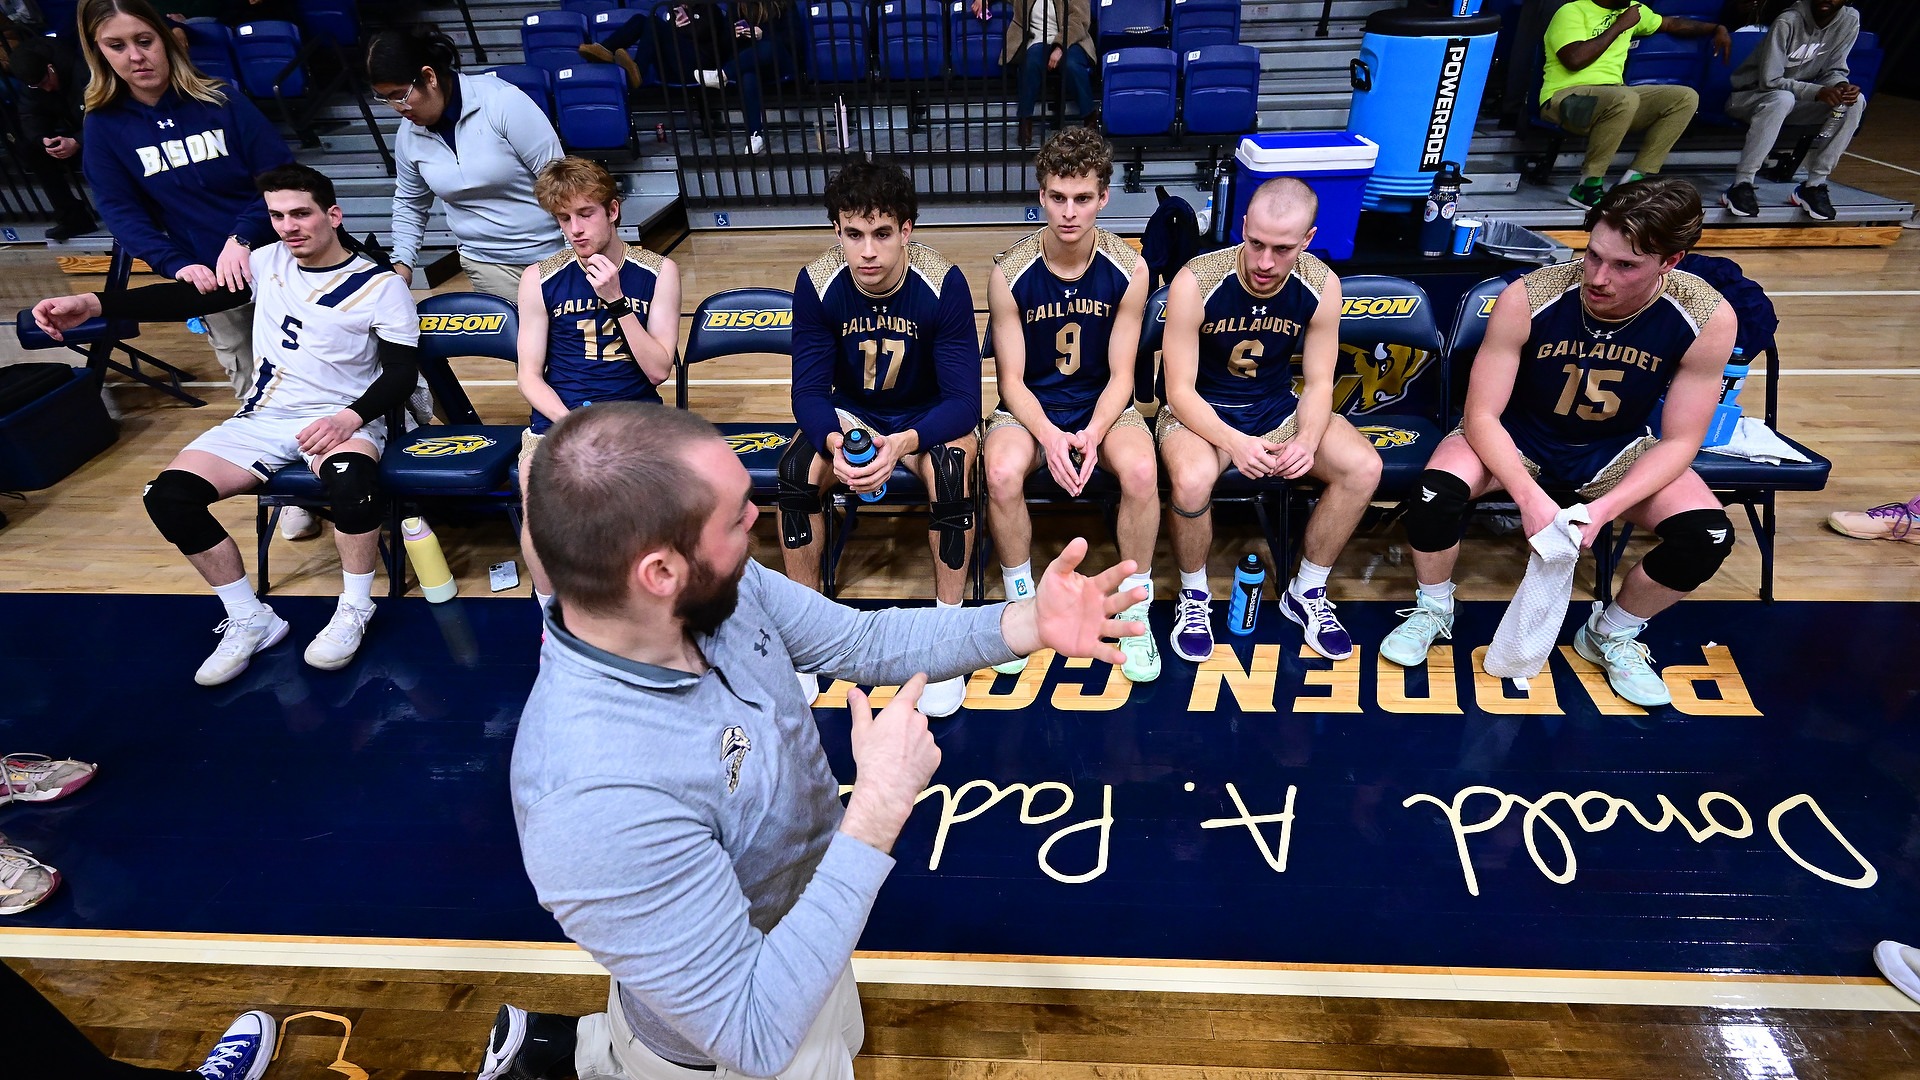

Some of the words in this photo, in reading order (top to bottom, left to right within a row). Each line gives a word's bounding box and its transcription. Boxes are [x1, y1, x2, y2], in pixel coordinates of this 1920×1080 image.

[1424, 46, 1466, 165] POWERADE
[136, 129, 229, 177] BISON
[419, 315, 503, 331] BISON
[707, 311, 793, 327] BISON
[1027, 298, 1112, 324] GALLAUDET
[1201, 316, 1302, 337] GALLAUDET
[1341, 298, 1417, 315] ISON
[281, 315, 302, 350] 5
[577, 318, 632, 361] 12
[1055, 322, 1081, 375] 9
[858, 338, 905, 390] 17
[1227, 339, 1264, 378] 6
[1537, 340, 1662, 373] GALLAUDET
[1553, 363, 1624, 421] 15
[1246, 587, 1259, 627] POWERADE
[840, 779, 1113, 884] Pad
[1184, 781, 1297, 873] A.
[1402, 786, 1878, 896] Donald
